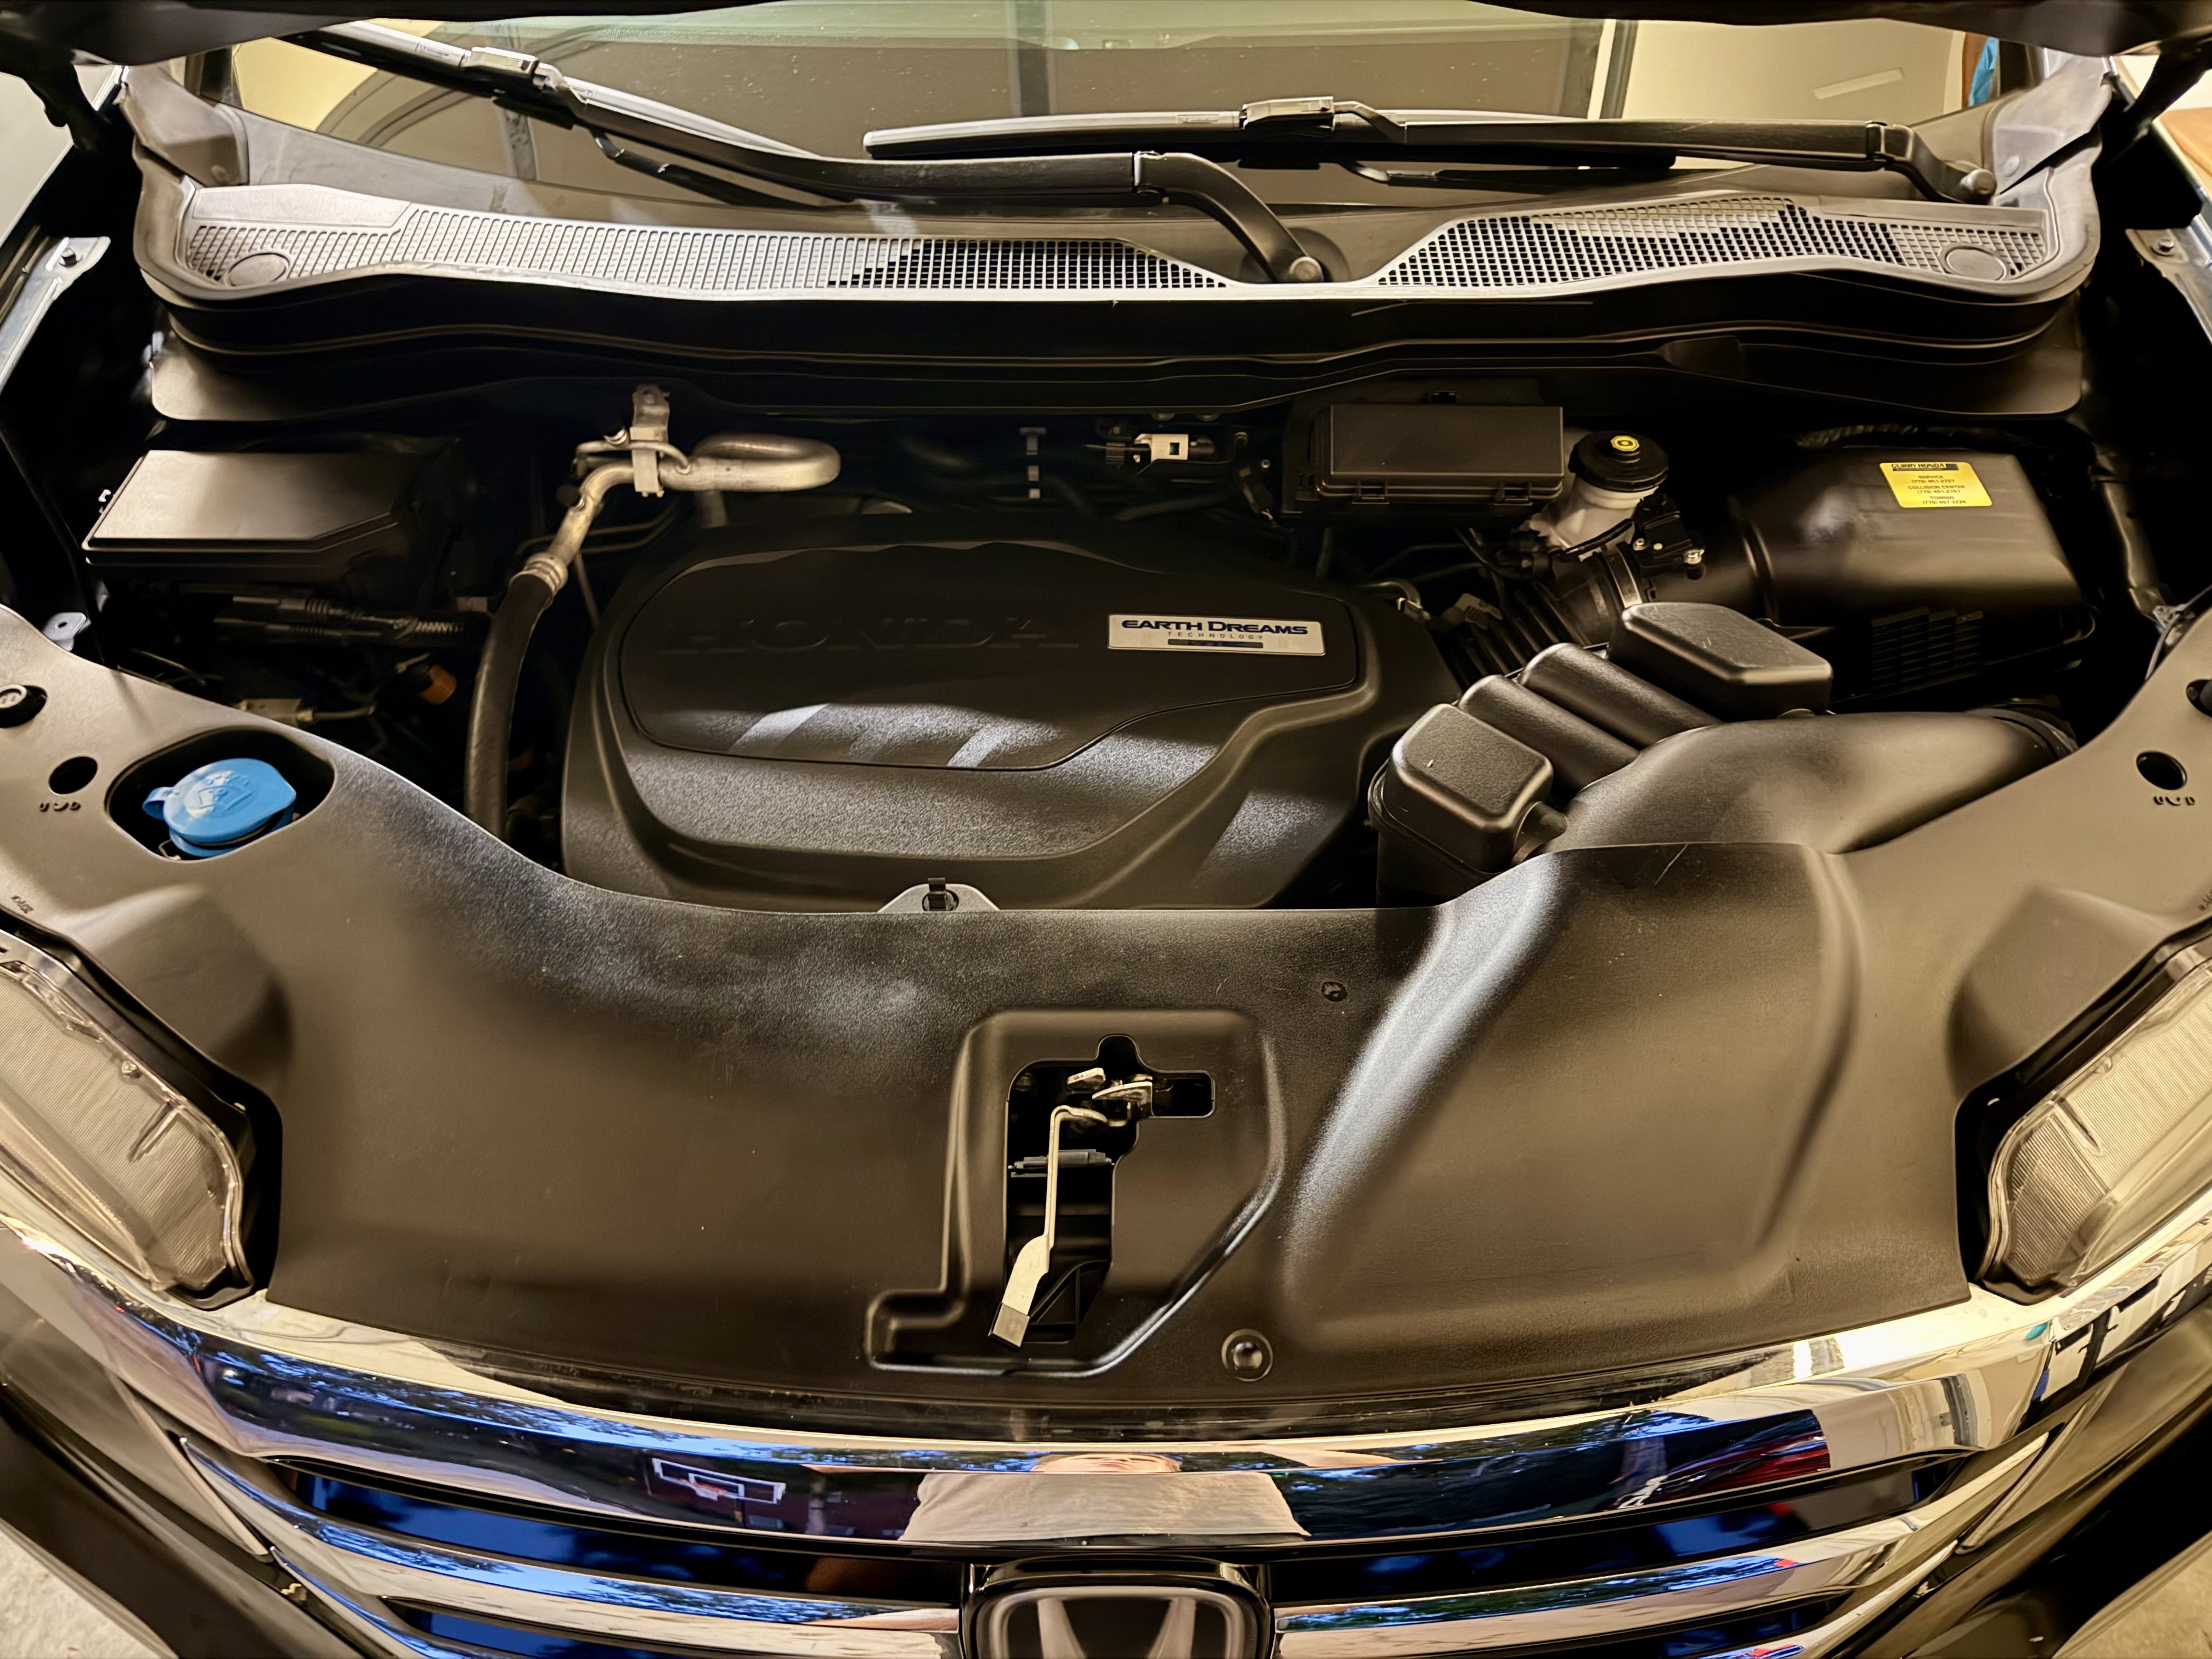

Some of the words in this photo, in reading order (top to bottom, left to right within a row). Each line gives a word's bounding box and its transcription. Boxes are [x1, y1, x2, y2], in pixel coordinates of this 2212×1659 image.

[1121, 620, 1203, 631] EARTH
[1207, 621, 1308, 635] DREAMS
[657, 617, 1080, 654] HONDA
[1167, 631, 1263, 640] TECHNOLOGY
